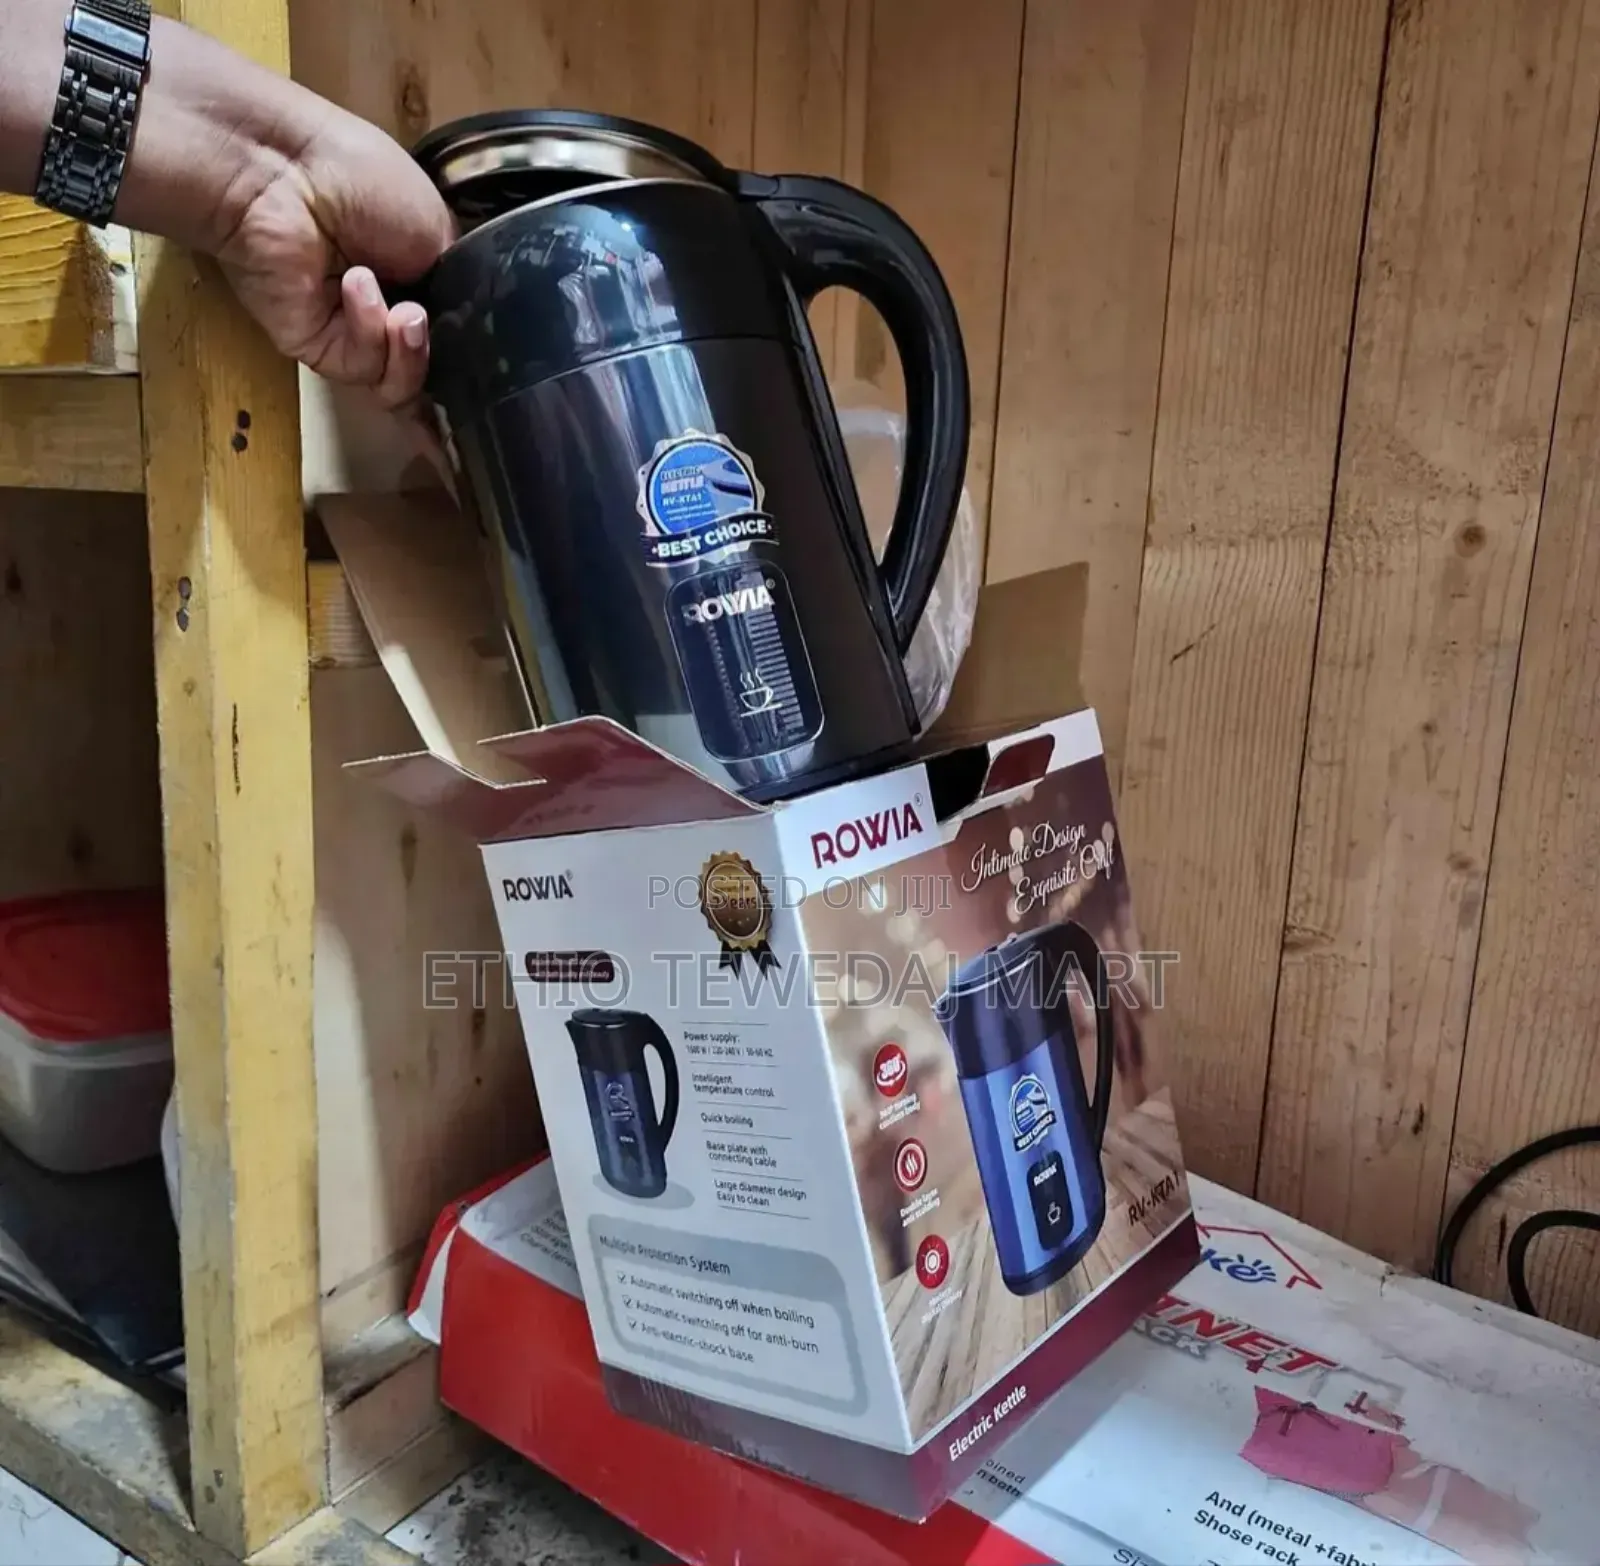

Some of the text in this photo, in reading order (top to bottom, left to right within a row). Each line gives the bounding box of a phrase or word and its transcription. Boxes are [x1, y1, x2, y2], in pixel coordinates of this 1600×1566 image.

[657, 519, 767, 557] BEST CHOICE
[961, 820, 1086, 892] Intimate Design
[1014, 859, 1077, 914] Exquisite
[684, 1031, 708, 1041] Power
[692, 1072, 732, 1085] Intelligent
[694, 1084, 775, 1097] temperature control
[700, 1112, 753, 1128] Quick boiling
[706, 1140, 768, 1156] Base plate with
[708, 1152, 777, 1168] connecting cable
[714, 1178, 806, 1201] Large diameter design
[717, 1190, 770, 1206] Easy to clean
[600, 1235, 731, 1275] Multiple Protection System
[631, 1275, 815, 1329] Automatic switching off when boiling
[636, 1300, 820, 1354] Automatic switching off for anti-burn
[728, 1345, 755, 1363] base
[949, 1384, 1027, 1462] Electric Kettle
[1205, 1491, 1247, 1517] And
[1247, 1508, 1312, 1548] (metal
[1194, 1508, 1302, 1566] Shose rack
